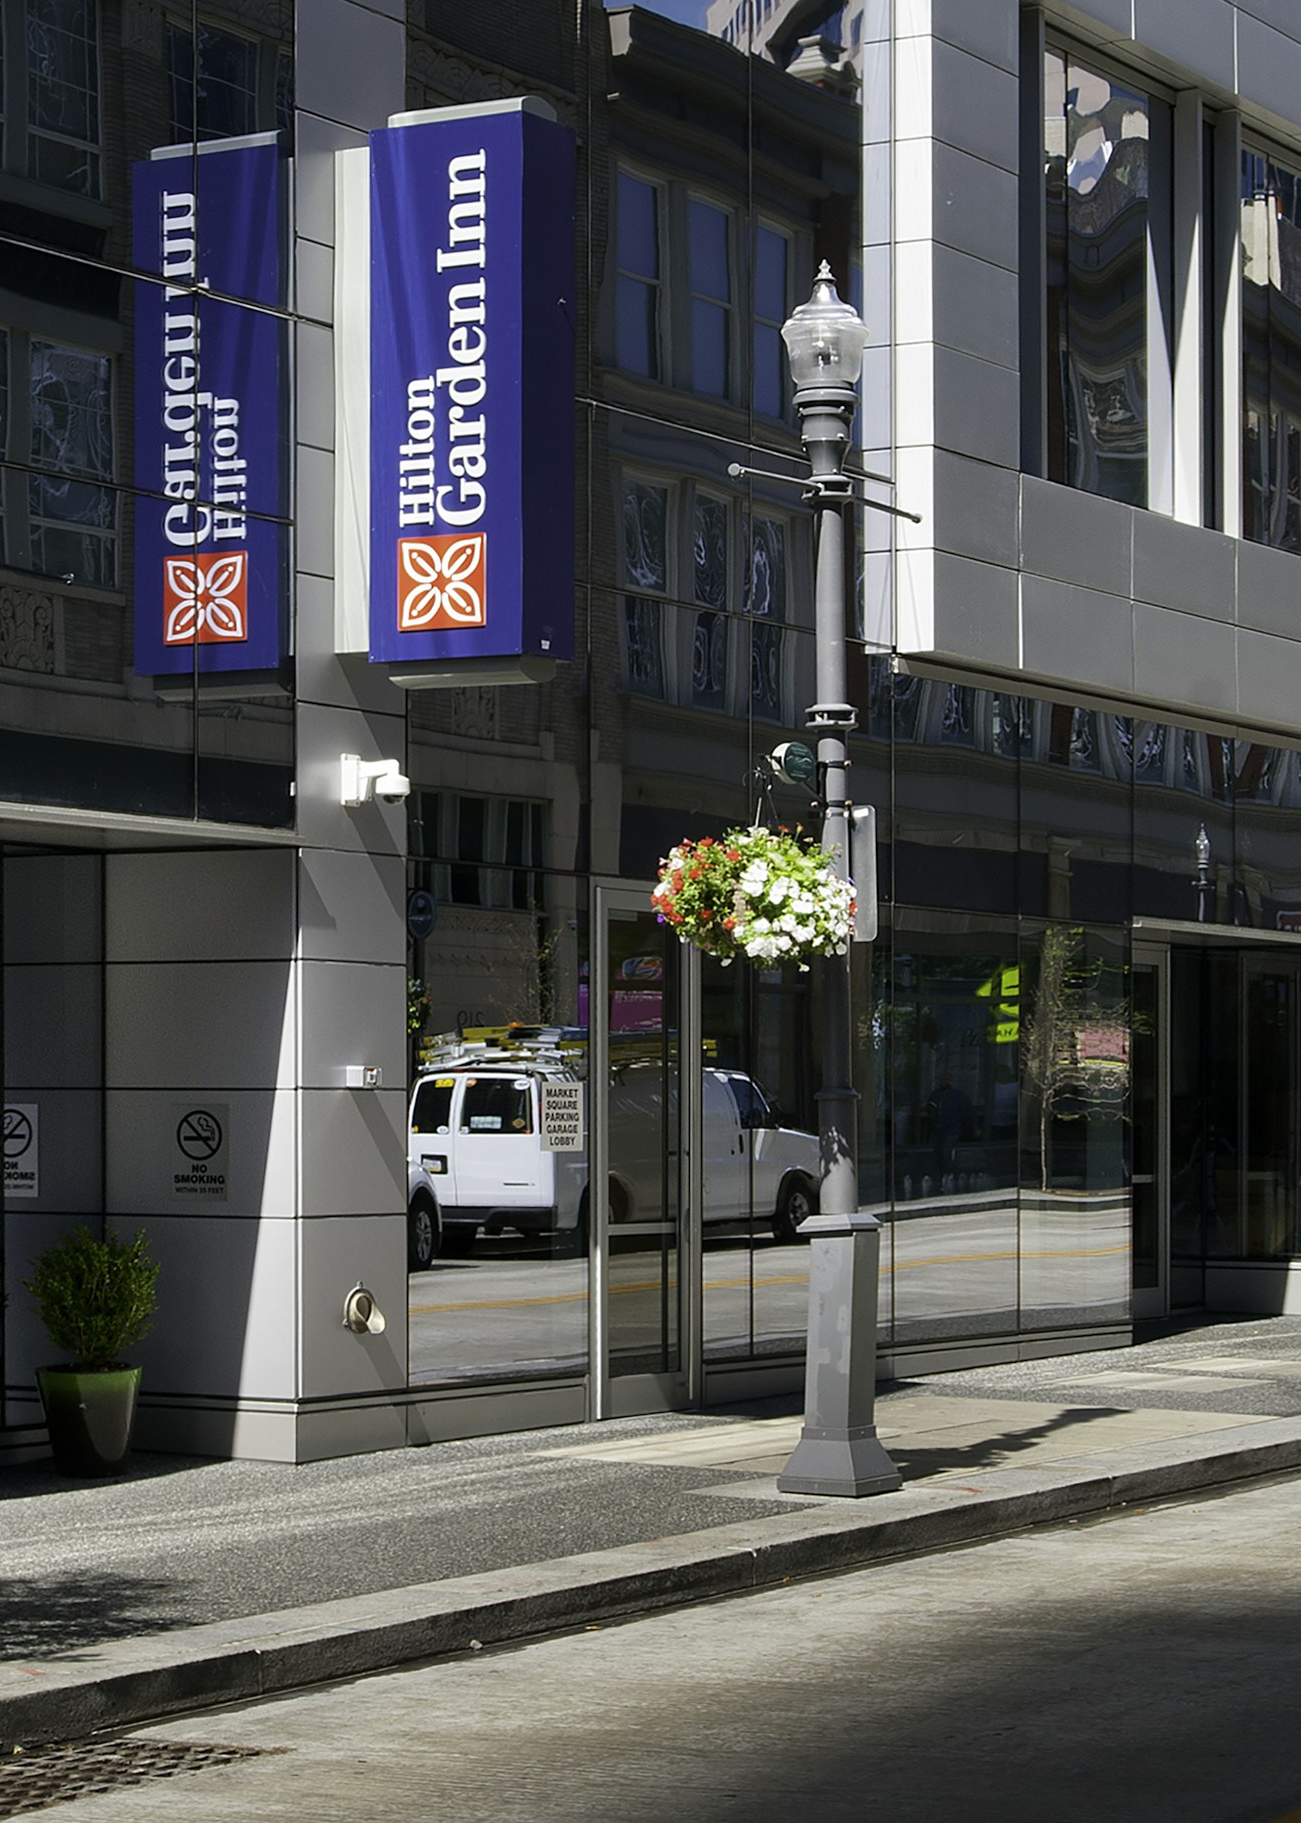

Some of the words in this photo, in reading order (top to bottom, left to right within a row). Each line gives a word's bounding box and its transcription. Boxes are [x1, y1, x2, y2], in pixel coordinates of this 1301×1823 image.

[436, 148, 487, 274] Inn
[435, 277, 487, 529] Garden
[399, 376, 435, 528] Hilton
[545, 1088, 578, 1098] MARKET
[546, 1100, 578, 1110] SQUARE
[545, 1112, 579, 1122] PARKING
[546, 1124, 578, 1134] GARAGE
[549, 1136, 576, 1146] LOBBY
[191, 1163, 208, 1174] NO
[173, 1174, 225, 1185] SMOKING
